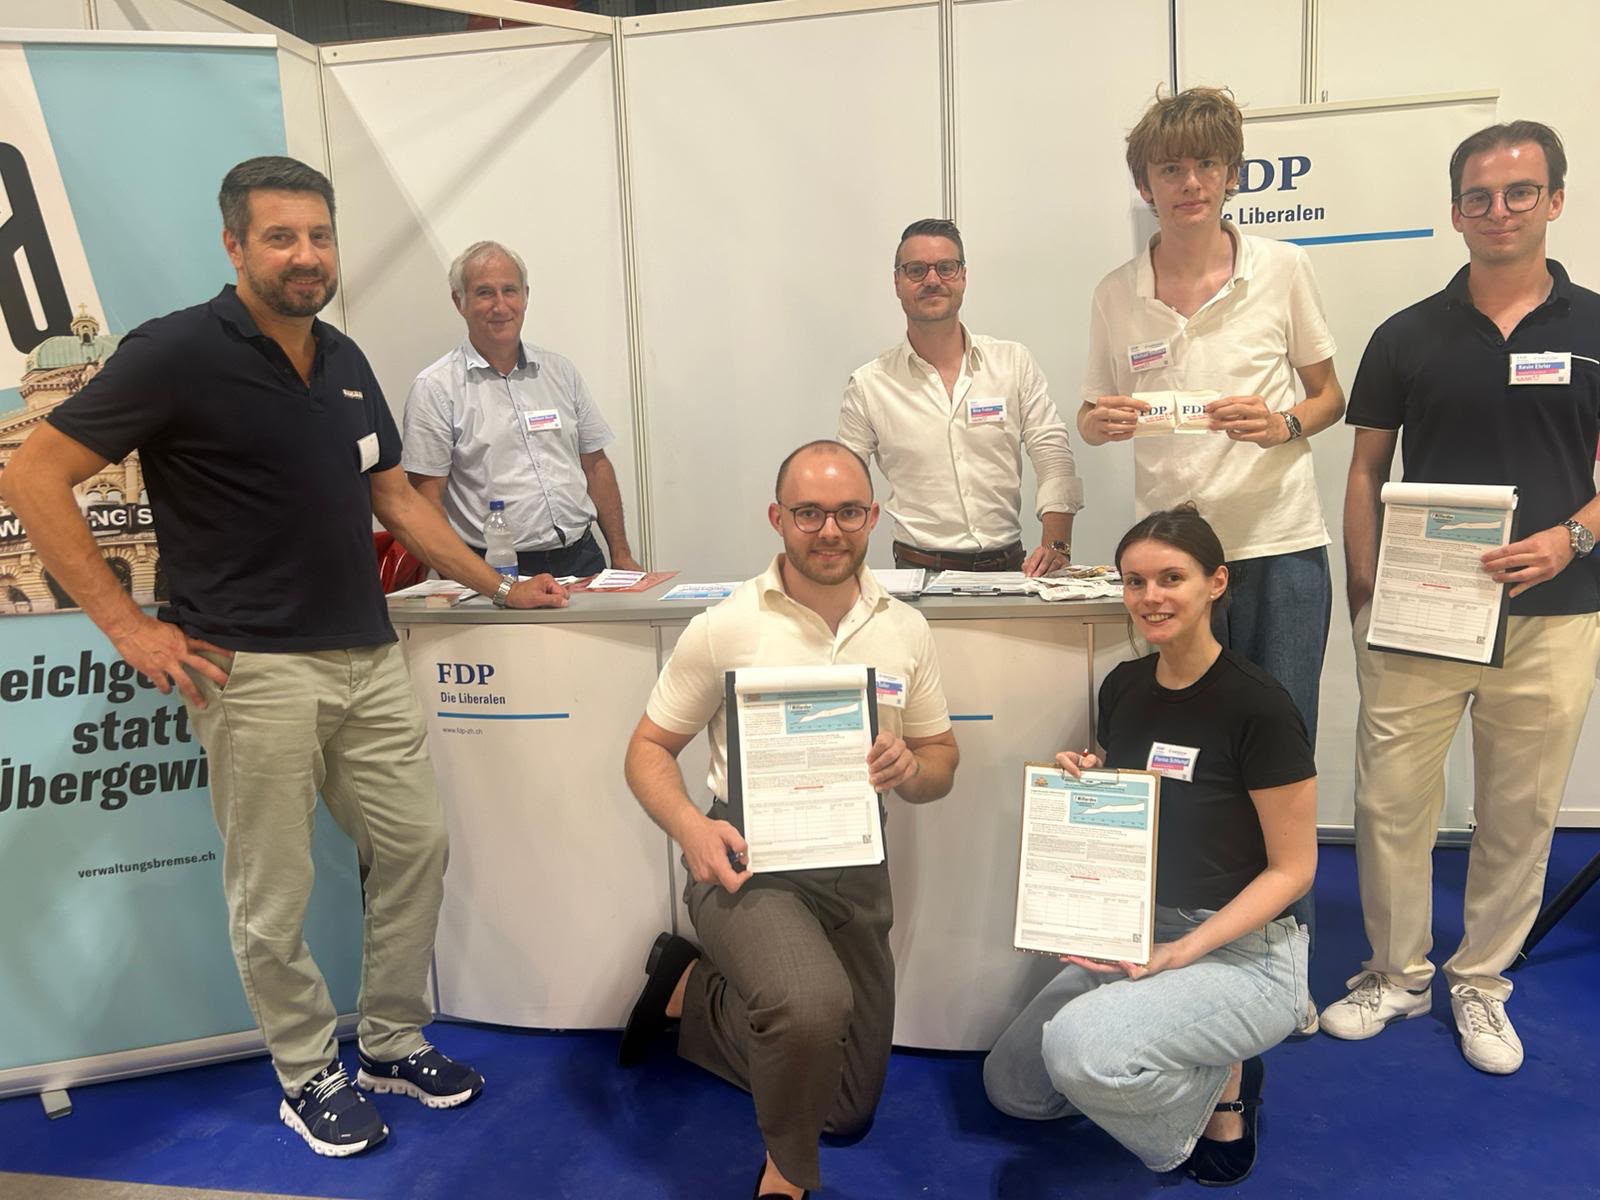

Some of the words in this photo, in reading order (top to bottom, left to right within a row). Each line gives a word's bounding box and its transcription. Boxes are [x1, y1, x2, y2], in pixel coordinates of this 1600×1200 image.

[1238, 156, 1311, 193] DP
[1239, 204, 1325, 225] Liberalen
[436, 662, 495, 685] FDP
[440, 692, 457, 703] Die
[459, 693, 506, 705] Liberalen
[72, 706, 192, 755] statt
[442, 727, 483, 735] www.fdp-zh.ch
[78, 851, 216, 878] verwaltungsbremse.ch
